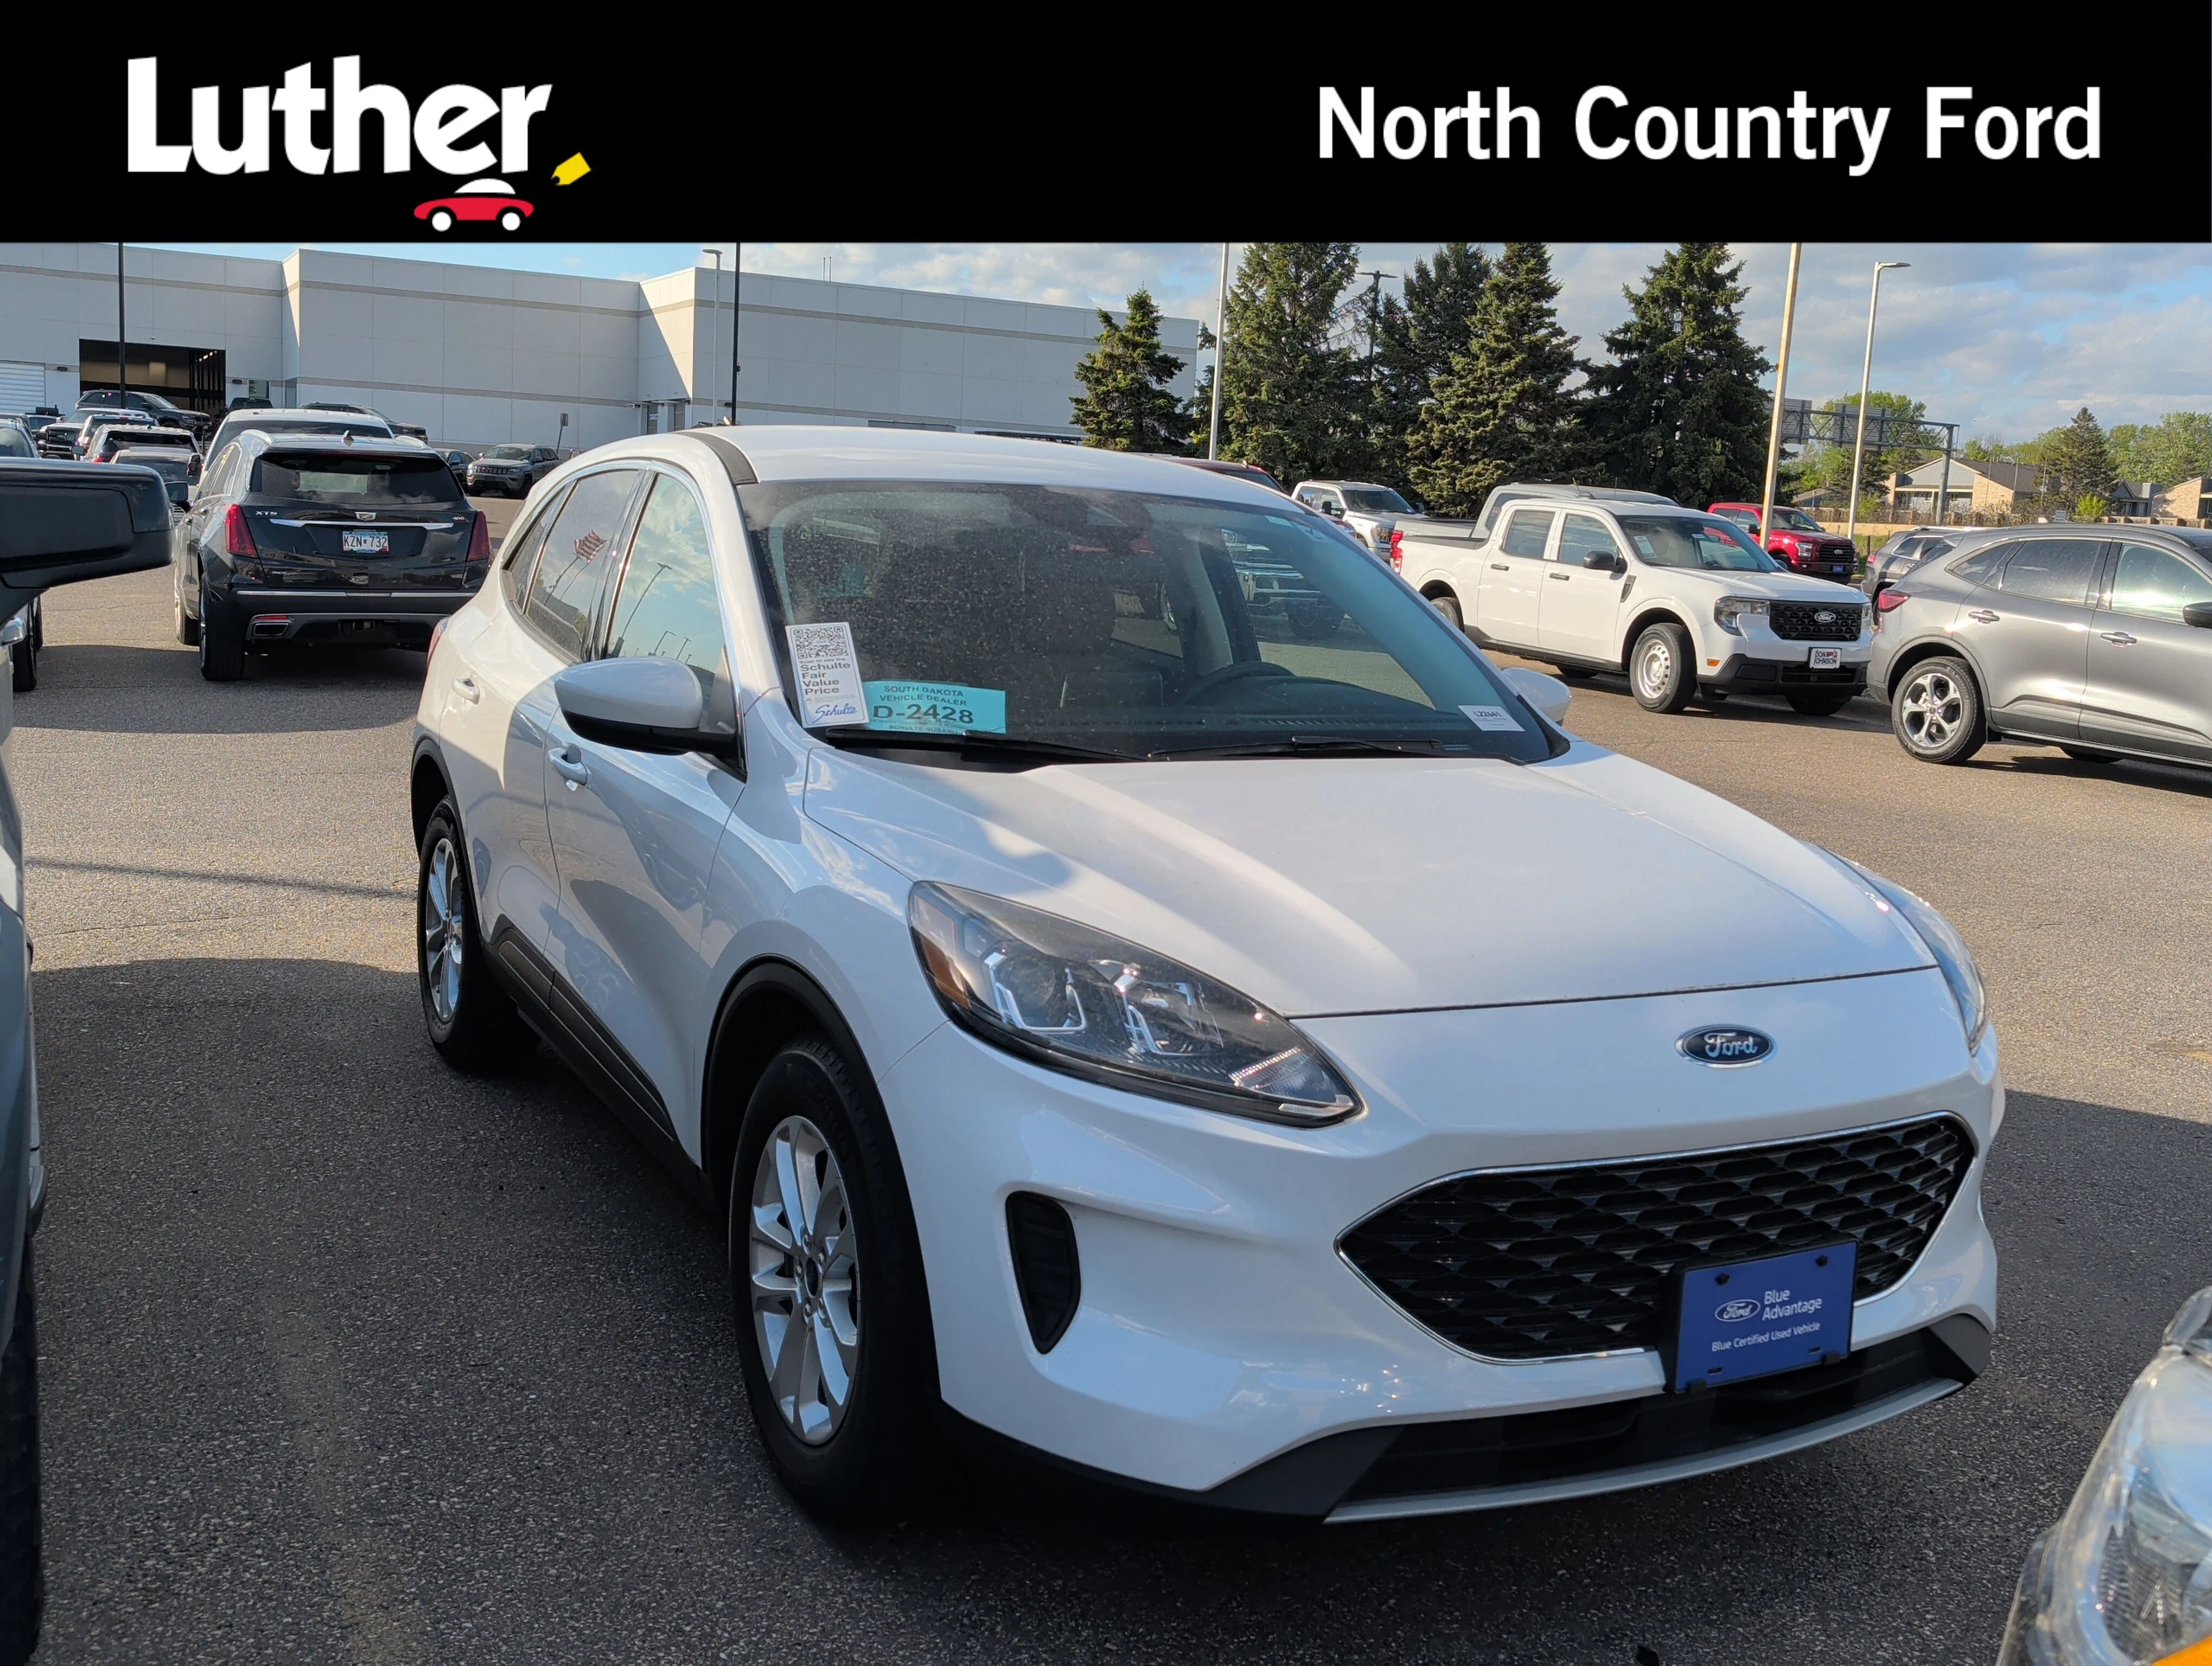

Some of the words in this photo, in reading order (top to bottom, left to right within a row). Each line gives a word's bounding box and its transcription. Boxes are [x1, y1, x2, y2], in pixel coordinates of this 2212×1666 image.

[344, 535, 362, 547] KZN
[369, 536, 387, 548] 732
[800, 662, 851, 671] Schulte
[802, 671, 827, 680] Fair
[802, 679, 840, 687] Value
[805, 687, 840, 696] Price
[922, 686, 963, 697] DAKOTA
[926, 695, 967, 706] DEALER
[812, 703, 858, 724] Schulte
[873, 703, 974, 724] D-2428
[1703, 1031, 1758, 1058] Ford
[1764, 1289, 1791, 1304] Blue
[1722, 1302, 1753, 1319] Ford
[1761, 1298, 1823, 1321] Advantage
[1712, 1340, 1732, 1352] Blue
[1733, 1332, 1770, 1348] Certified
[1771, 1328, 1791, 1341] Used
[1793, 1321, 1821, 1335] Vehicle
